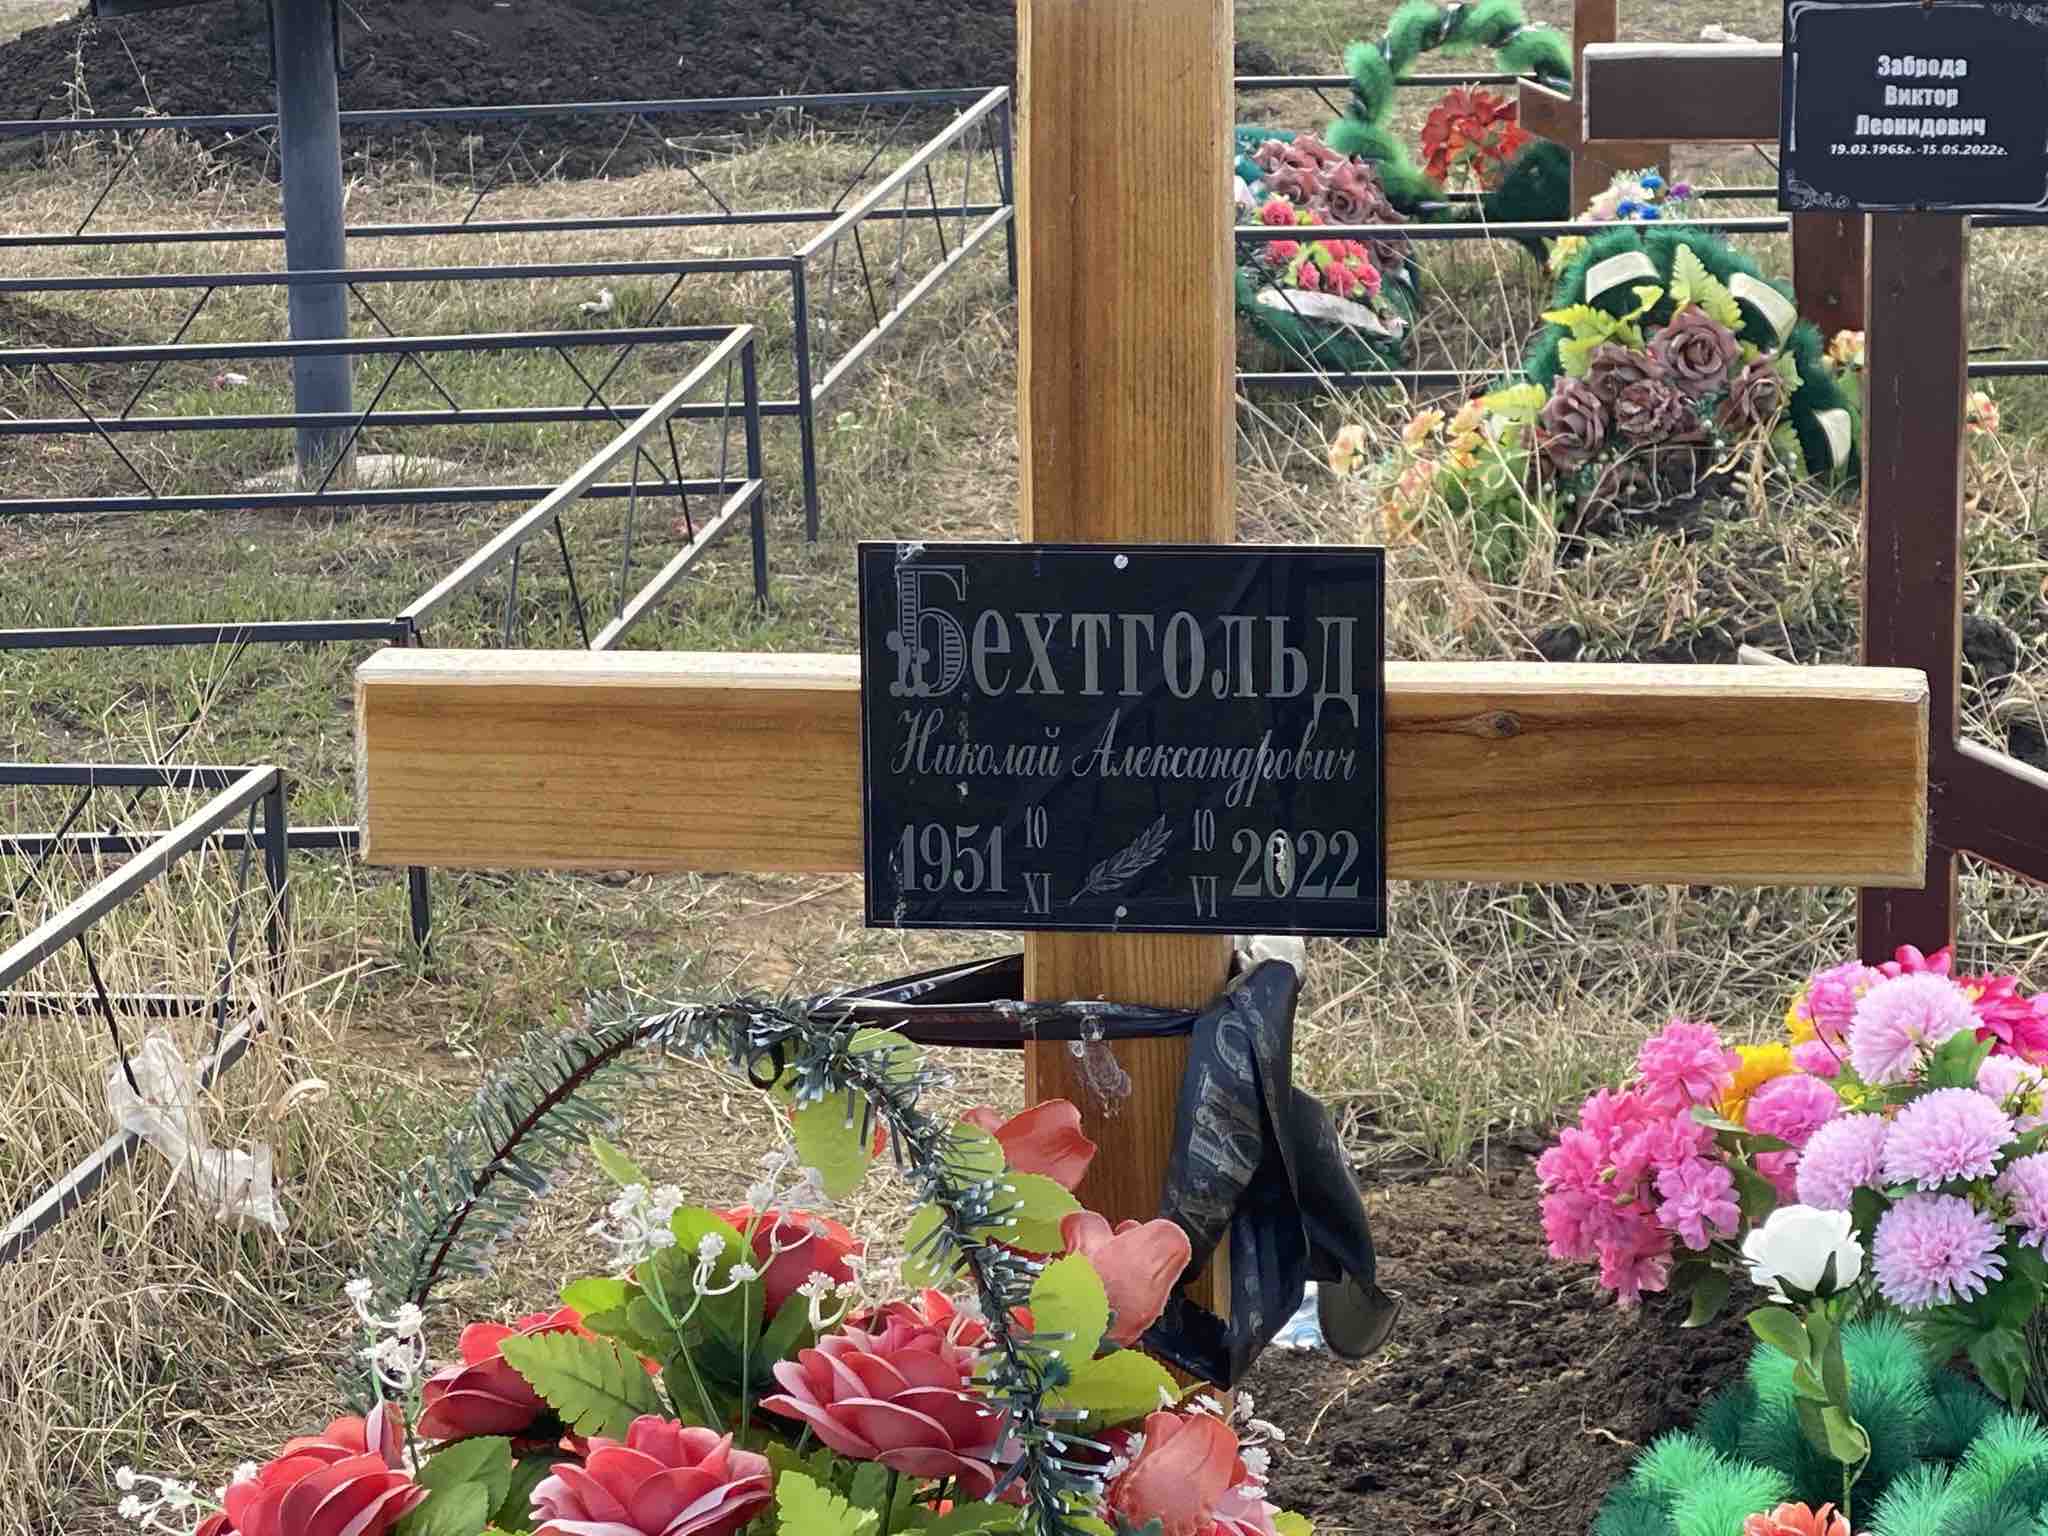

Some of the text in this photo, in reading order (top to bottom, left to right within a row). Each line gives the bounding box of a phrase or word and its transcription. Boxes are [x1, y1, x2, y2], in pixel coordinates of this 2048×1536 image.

[1877, 54, 1968, 78] Заброда
[1884, 85, 1959, 108] Виктор
[1855, 114, 1986, 138] Леонидович
[885, 564, 1360, 728] Бехтгольд
[891, 708, 1063, 778] Николай
[1072, 707, 1358, 807] Александрович
[1023, 805, 1048, 849] 10
[1192, 808, 1216, 852] 10
[899, 822, 1009, 893] 1951
[1230, 827, 1360, 899] 2022
